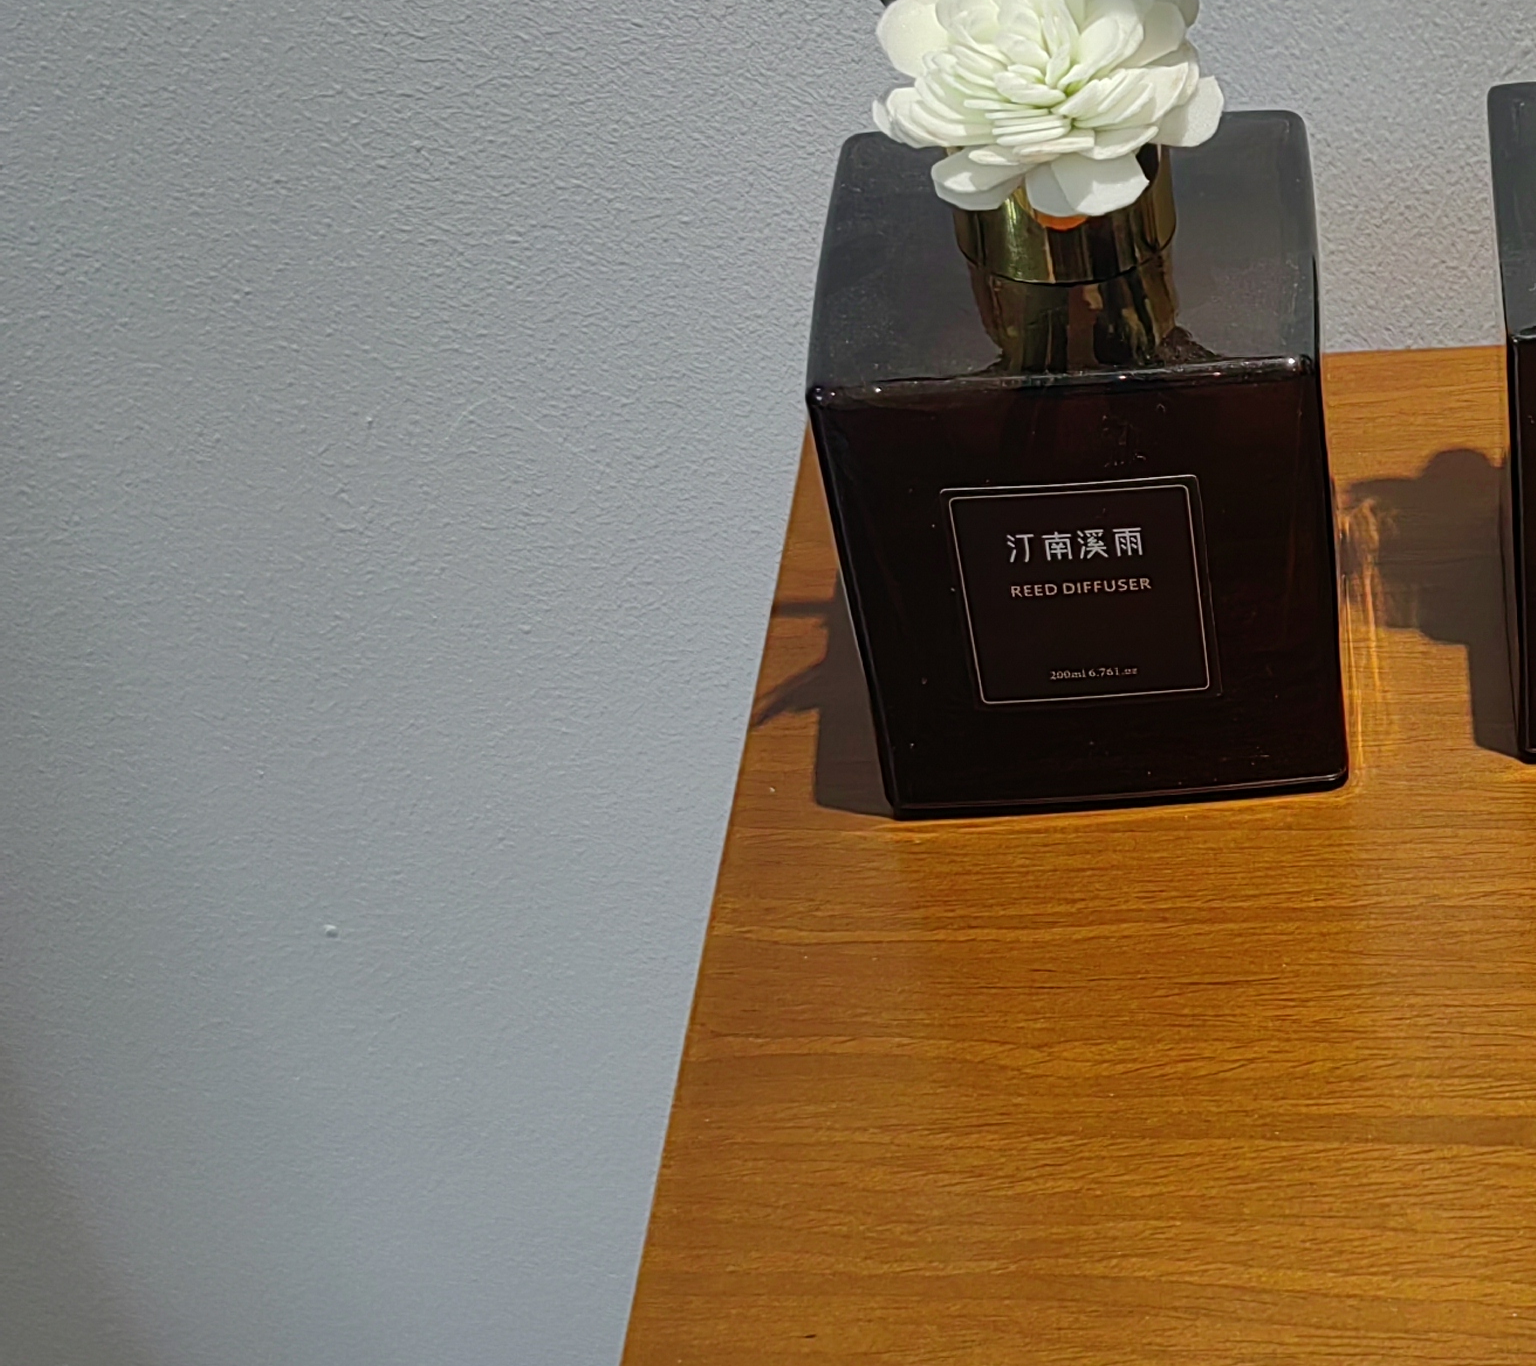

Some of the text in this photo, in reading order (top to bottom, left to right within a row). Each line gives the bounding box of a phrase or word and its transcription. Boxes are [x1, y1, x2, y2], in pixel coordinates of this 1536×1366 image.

[1006, 527, 1143, 563] 汀南溪雨
[1010, 577, 1152, 598] REED DIFFUSER
[1050, 669, 1087, 680] 200ml
